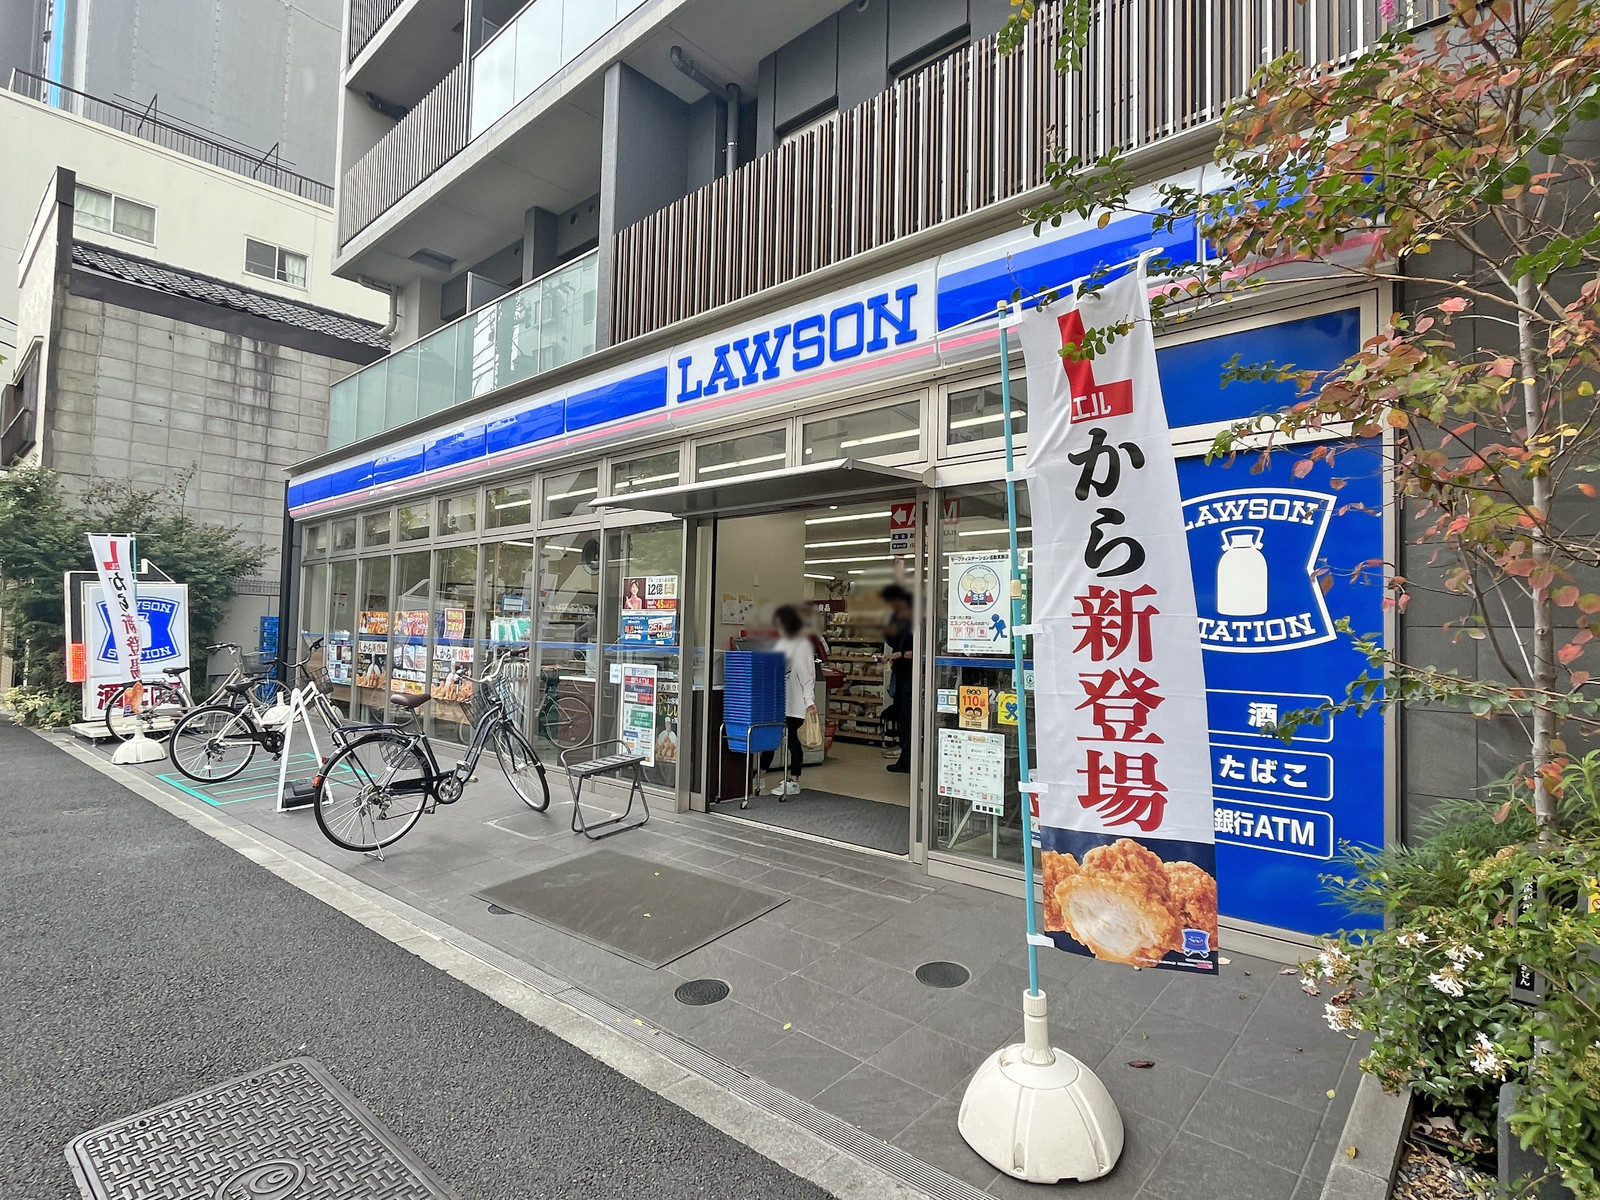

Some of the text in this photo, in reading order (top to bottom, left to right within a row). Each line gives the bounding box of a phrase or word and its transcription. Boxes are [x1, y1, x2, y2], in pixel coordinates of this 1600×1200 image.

[677, 284, 917, 403] LAWSON
[1072, 392, 1112, 420] エル
[1198, 613, 1316, 642] TATION
[1248, 702, 1278, 730] 酒
[1219, 755, 1308, 788] たばこ
[1214, 808, 1315, 846] 銀行ATM
